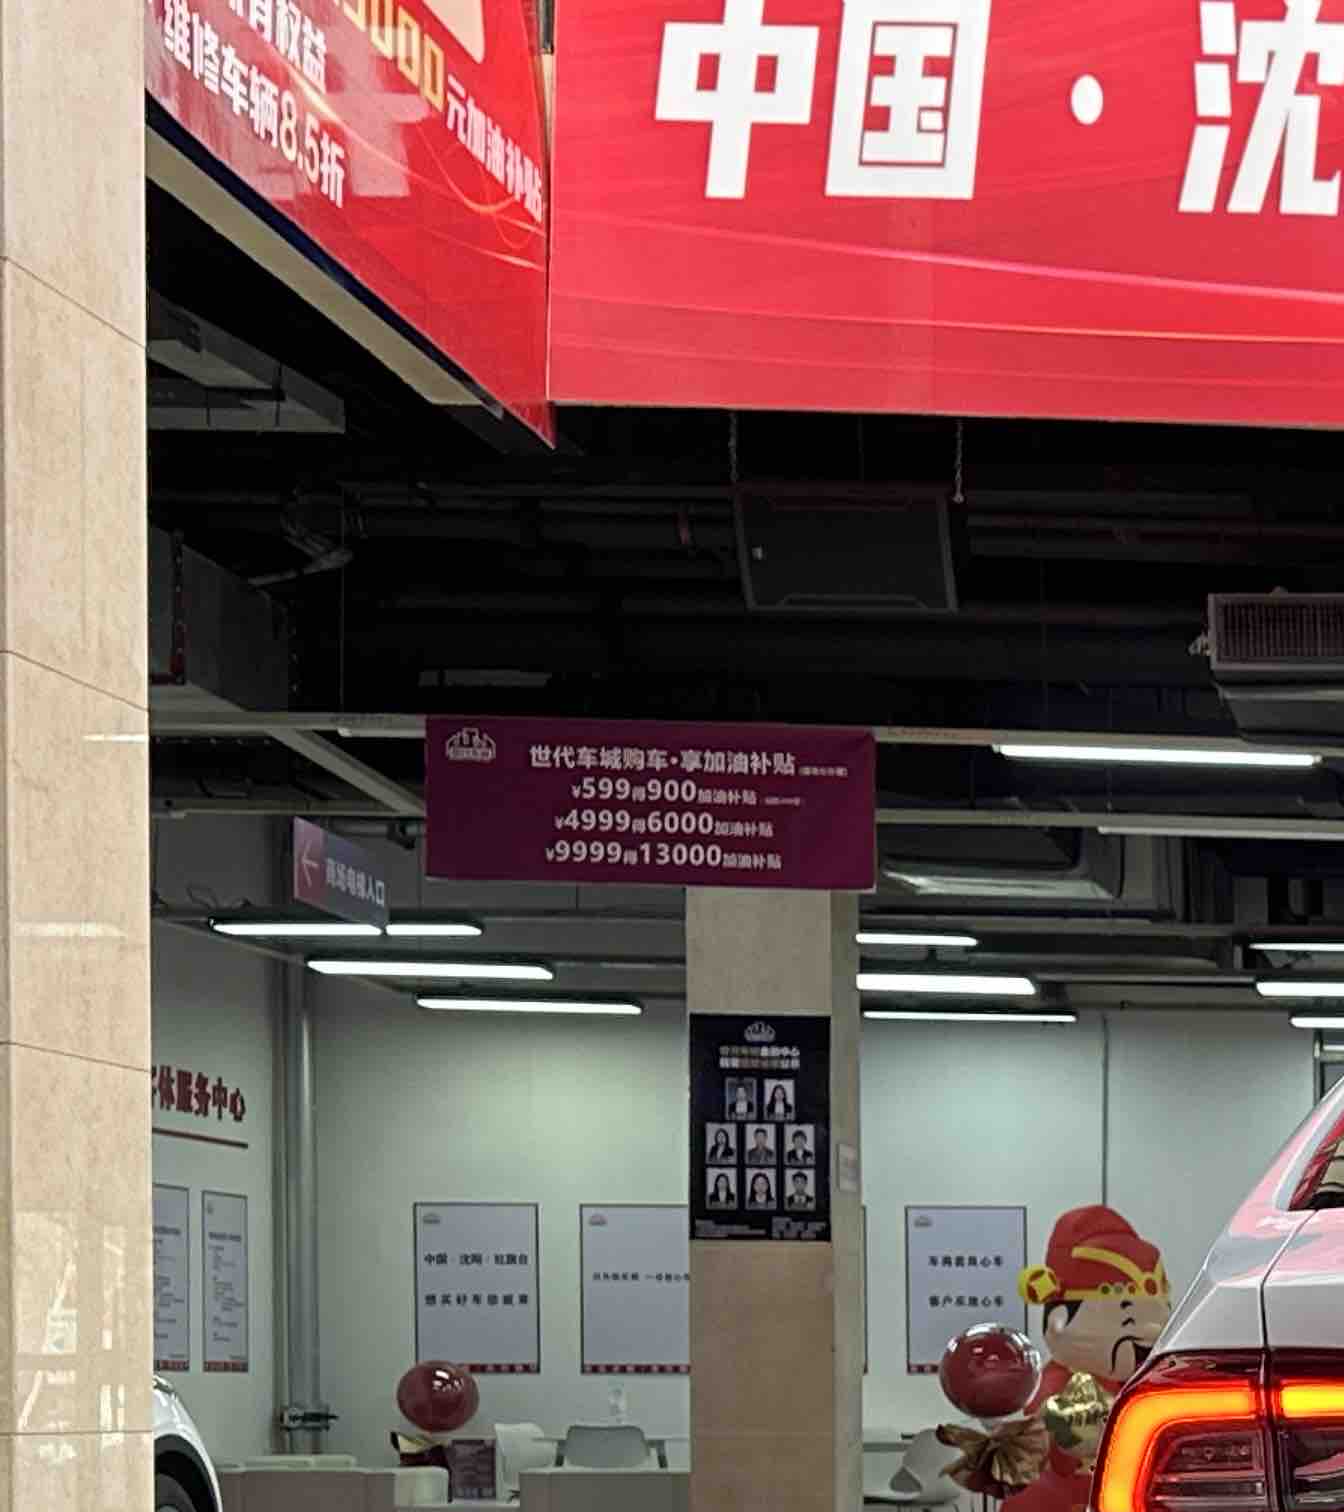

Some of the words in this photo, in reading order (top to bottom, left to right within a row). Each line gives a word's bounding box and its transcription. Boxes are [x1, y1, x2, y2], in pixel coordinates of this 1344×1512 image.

[530, 745, 795, 775] 世代车城购车·享加油补贴
